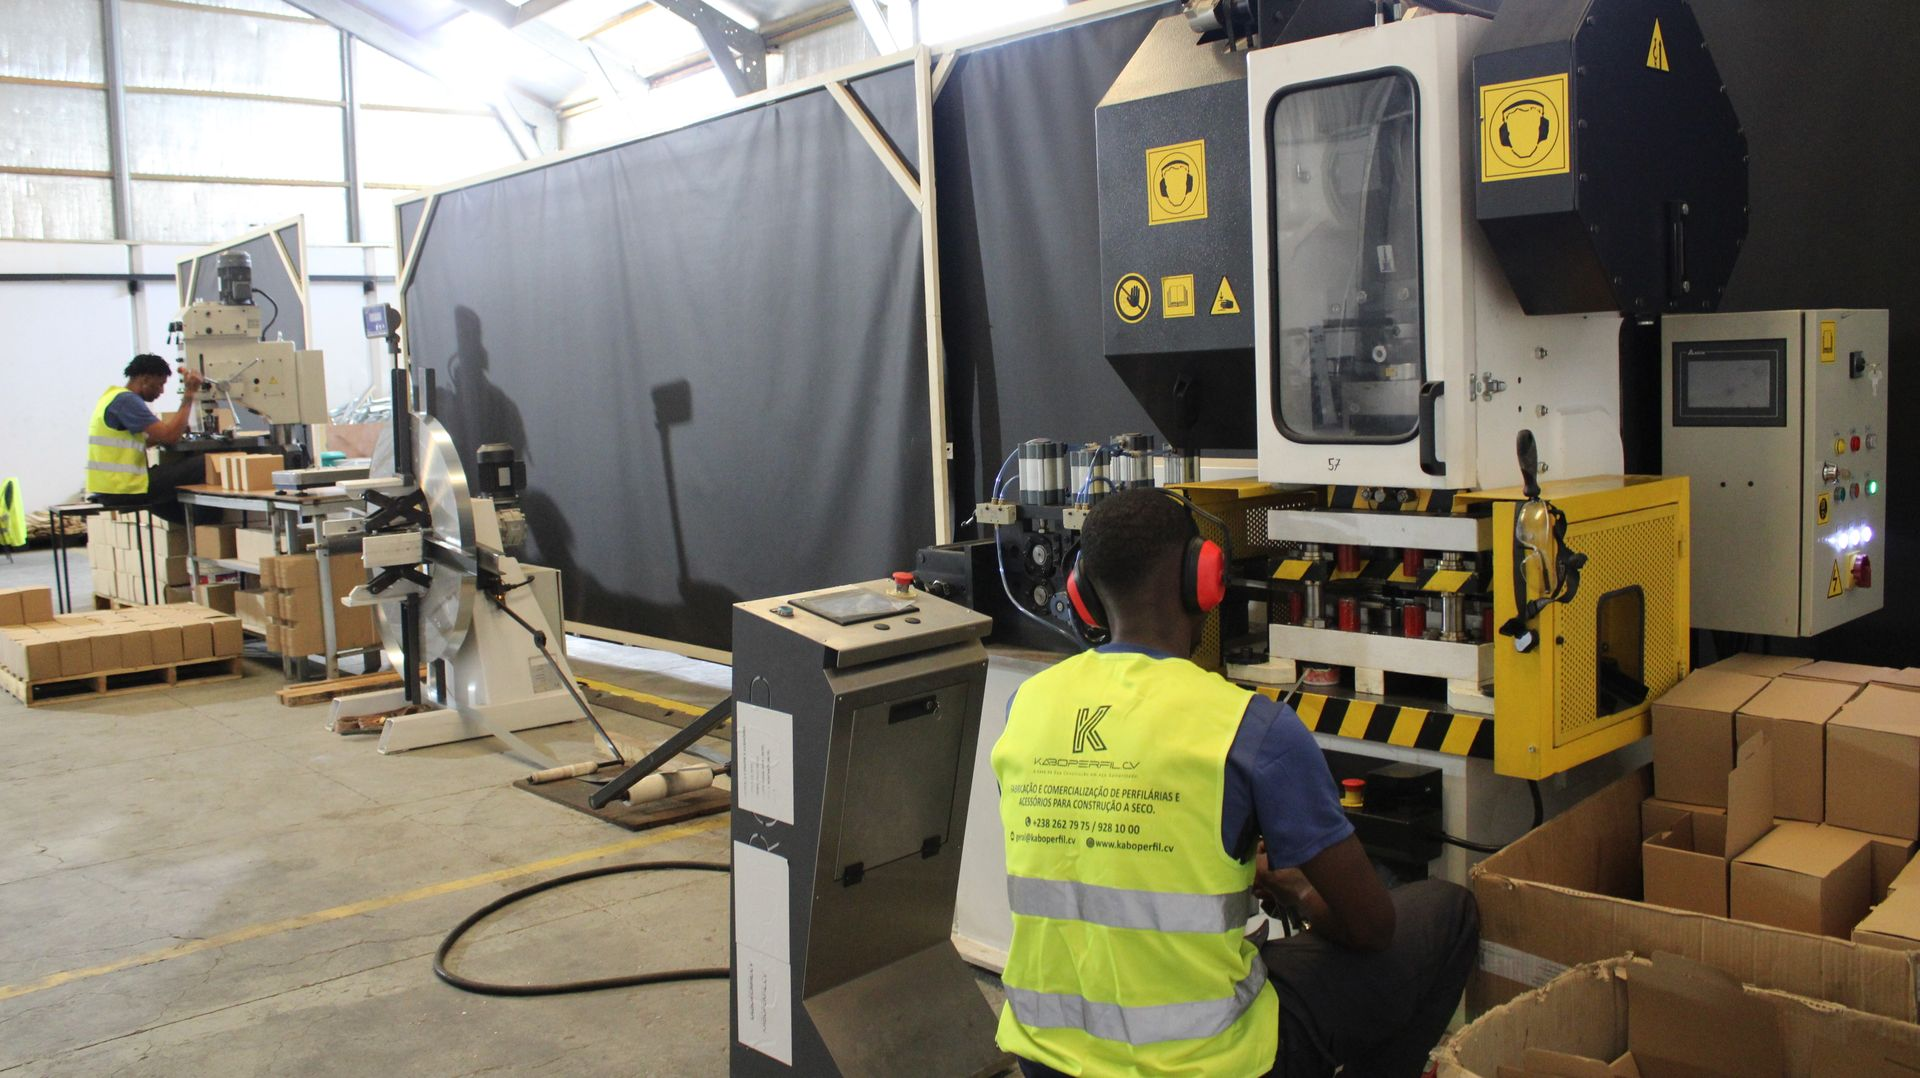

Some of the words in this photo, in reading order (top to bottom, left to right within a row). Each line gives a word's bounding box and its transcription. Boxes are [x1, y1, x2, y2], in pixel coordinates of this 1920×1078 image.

[1328, 457, 1341, 471] 57
[1072, 705, 1112, 754] K
[1039, 784, 1043, 794] E
[1044, 784, 1109, 799] COMERCIALIZAÇÃO
[1110, 788, 1120, 798] DE
[1122, 788, 1173, 802] PERFILÁRIAS
[1175, 792, 1180, 802] E
[1019, 794, 1052, 807] ACESSÓRIOS
[1053, 798, 1072, 808] PARA
[1073, 799, 1122, 813] CONSTRUÇÃO
[1123, 803, 1129, 812] A
[1131, 802, 1156, 814] SECO.
[1033, 818, 1050, 828] +238
[1052, 819, 1067, 829] 262
[1070, 820, 1079, 830] 79
[1081, 821, 1090, 831] 75
[1098, 822, 1112, 833] 928
[1115, 824, 1126, 834] 10
[1128, 824, 1140, 835] 00
[1095, 840, 1174, 853] www.kaboperfil.cv
